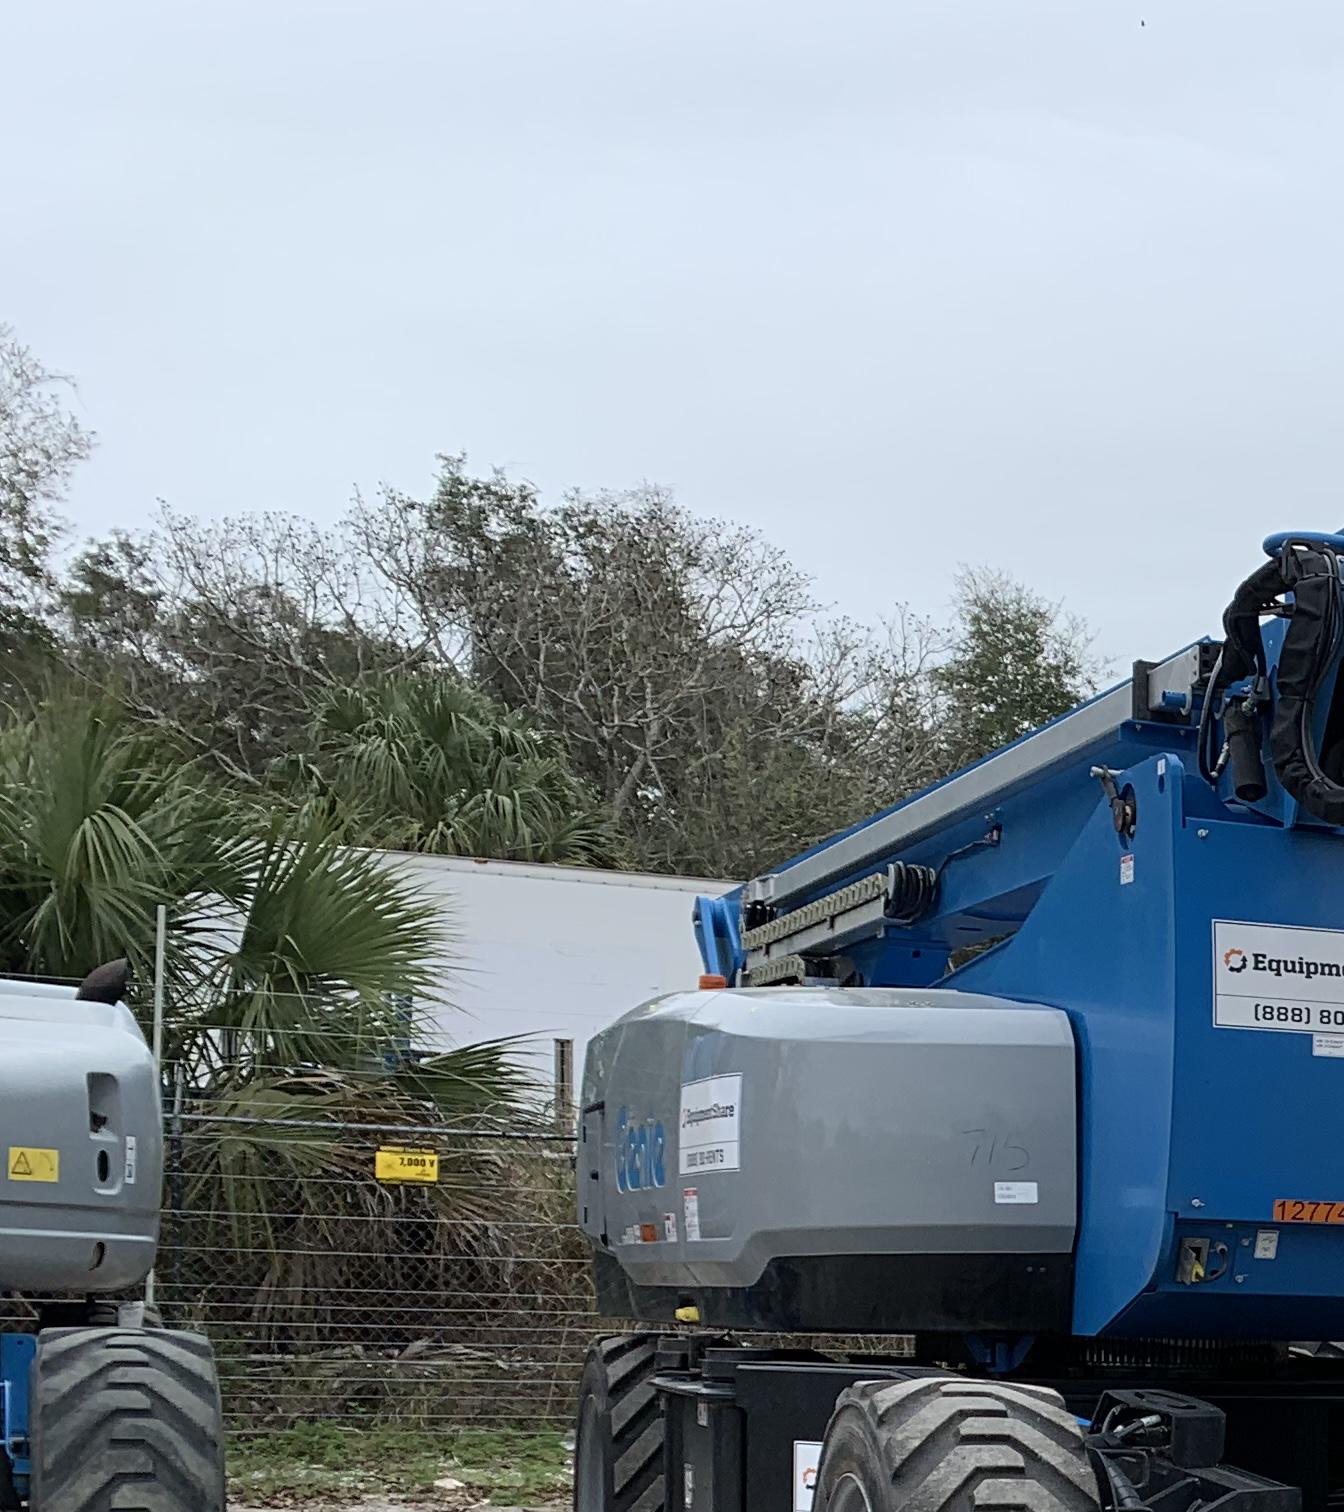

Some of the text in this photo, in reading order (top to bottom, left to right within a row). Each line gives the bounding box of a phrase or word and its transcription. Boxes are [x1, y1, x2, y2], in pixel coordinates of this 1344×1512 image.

[1253, 1004, 1312, 1025] (888)
[399, 1157, 436, 1168] 7,000 V
